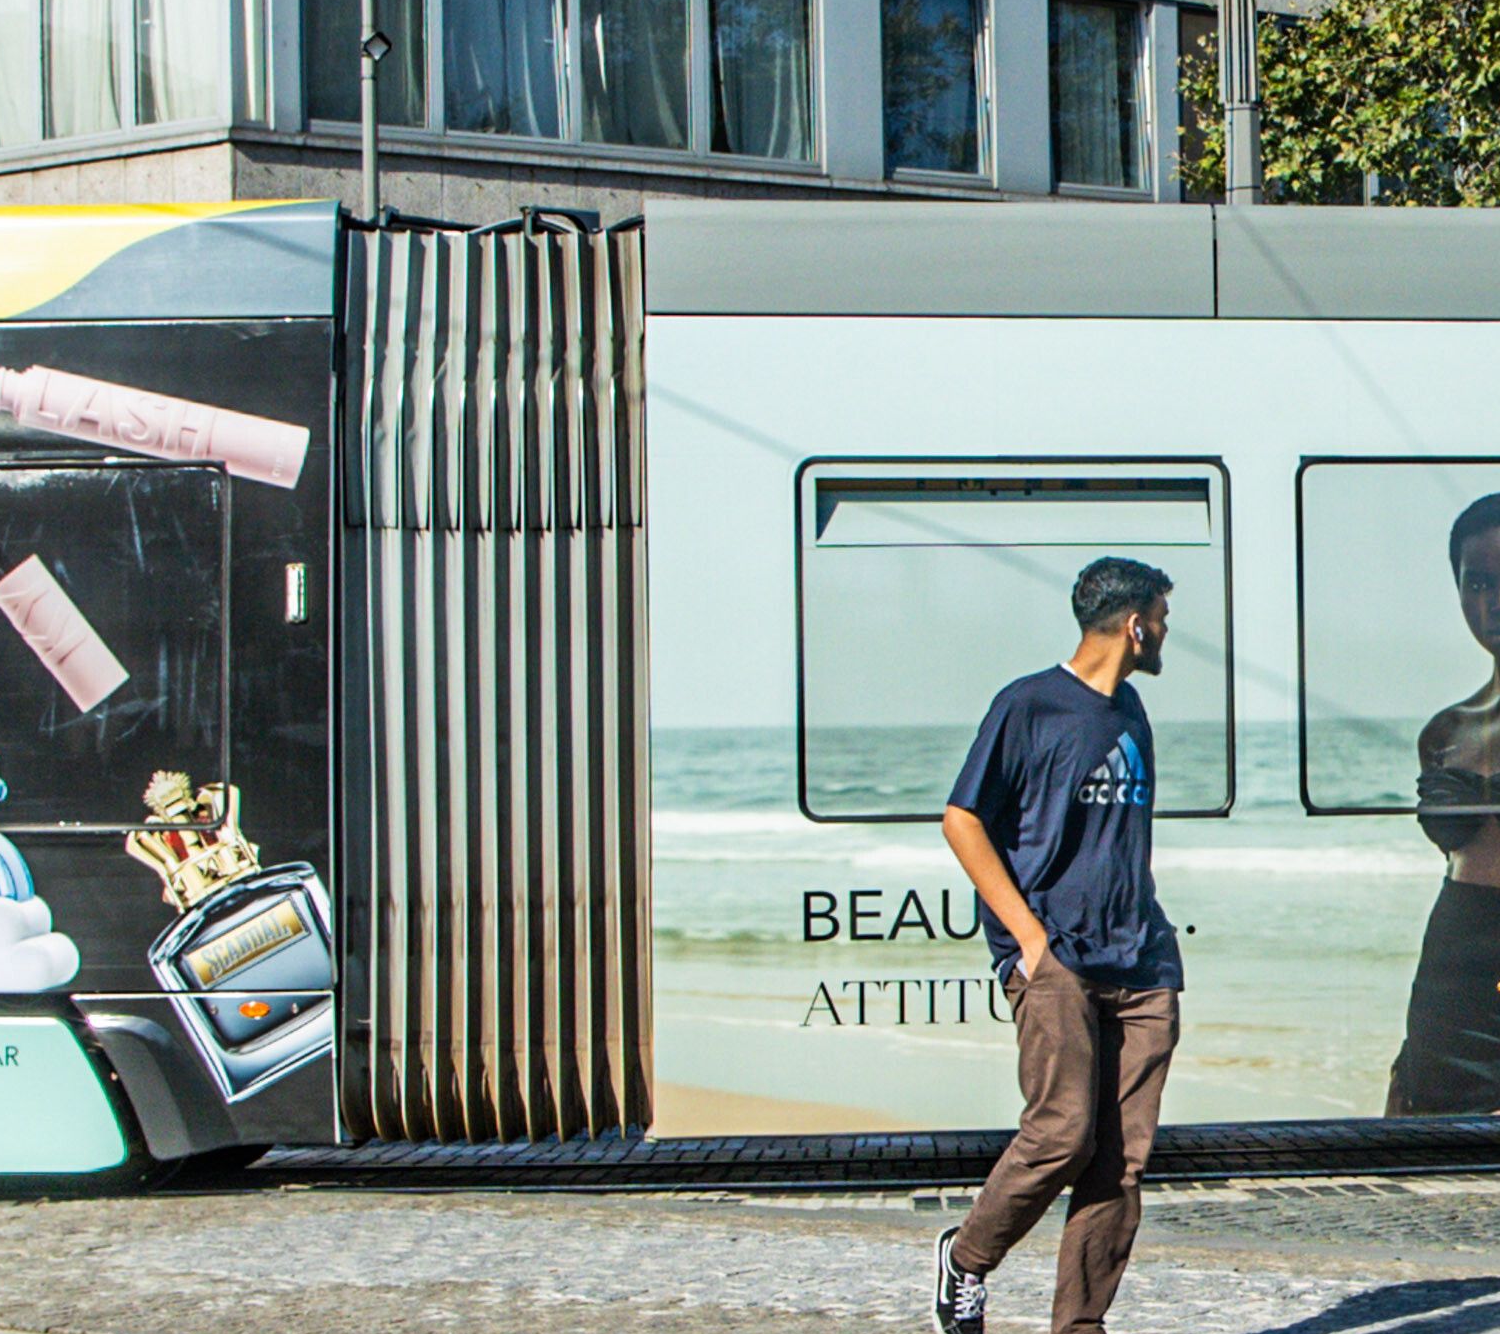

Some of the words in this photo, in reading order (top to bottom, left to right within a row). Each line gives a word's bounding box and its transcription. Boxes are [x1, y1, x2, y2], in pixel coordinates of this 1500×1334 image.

[18, 367, 218, 459] LASH
[1078, 776, 1150, 805] adida
[803, 889, 981, 942] BEAU
[199, 911, 294, 981] SCANDAL
[799, 978, 1016, 1027] ATTITU
